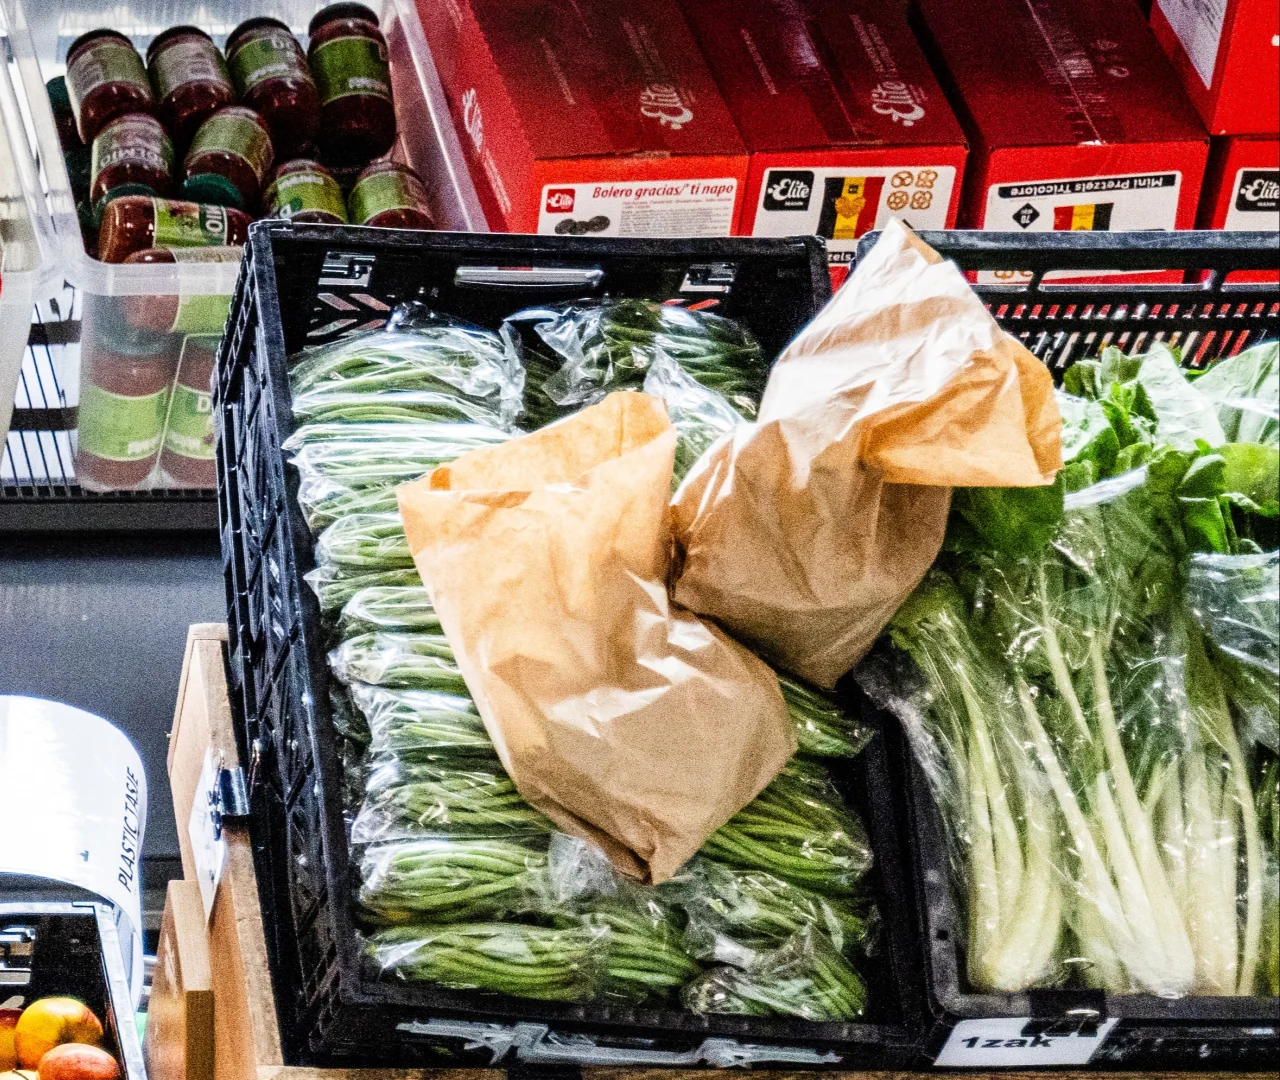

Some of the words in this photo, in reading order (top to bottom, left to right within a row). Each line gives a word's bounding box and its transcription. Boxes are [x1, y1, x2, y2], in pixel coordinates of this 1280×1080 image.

[771, 178, 811, 201] Elite
[1010, 182, 1072, 197] Tricolore
[1073, 179, 1130, 193] Pretzels
[1132, 176, 1163, 189] Mini
[592, 186, 633, 199] Bolero
[702, 185, 734, 198] napo
